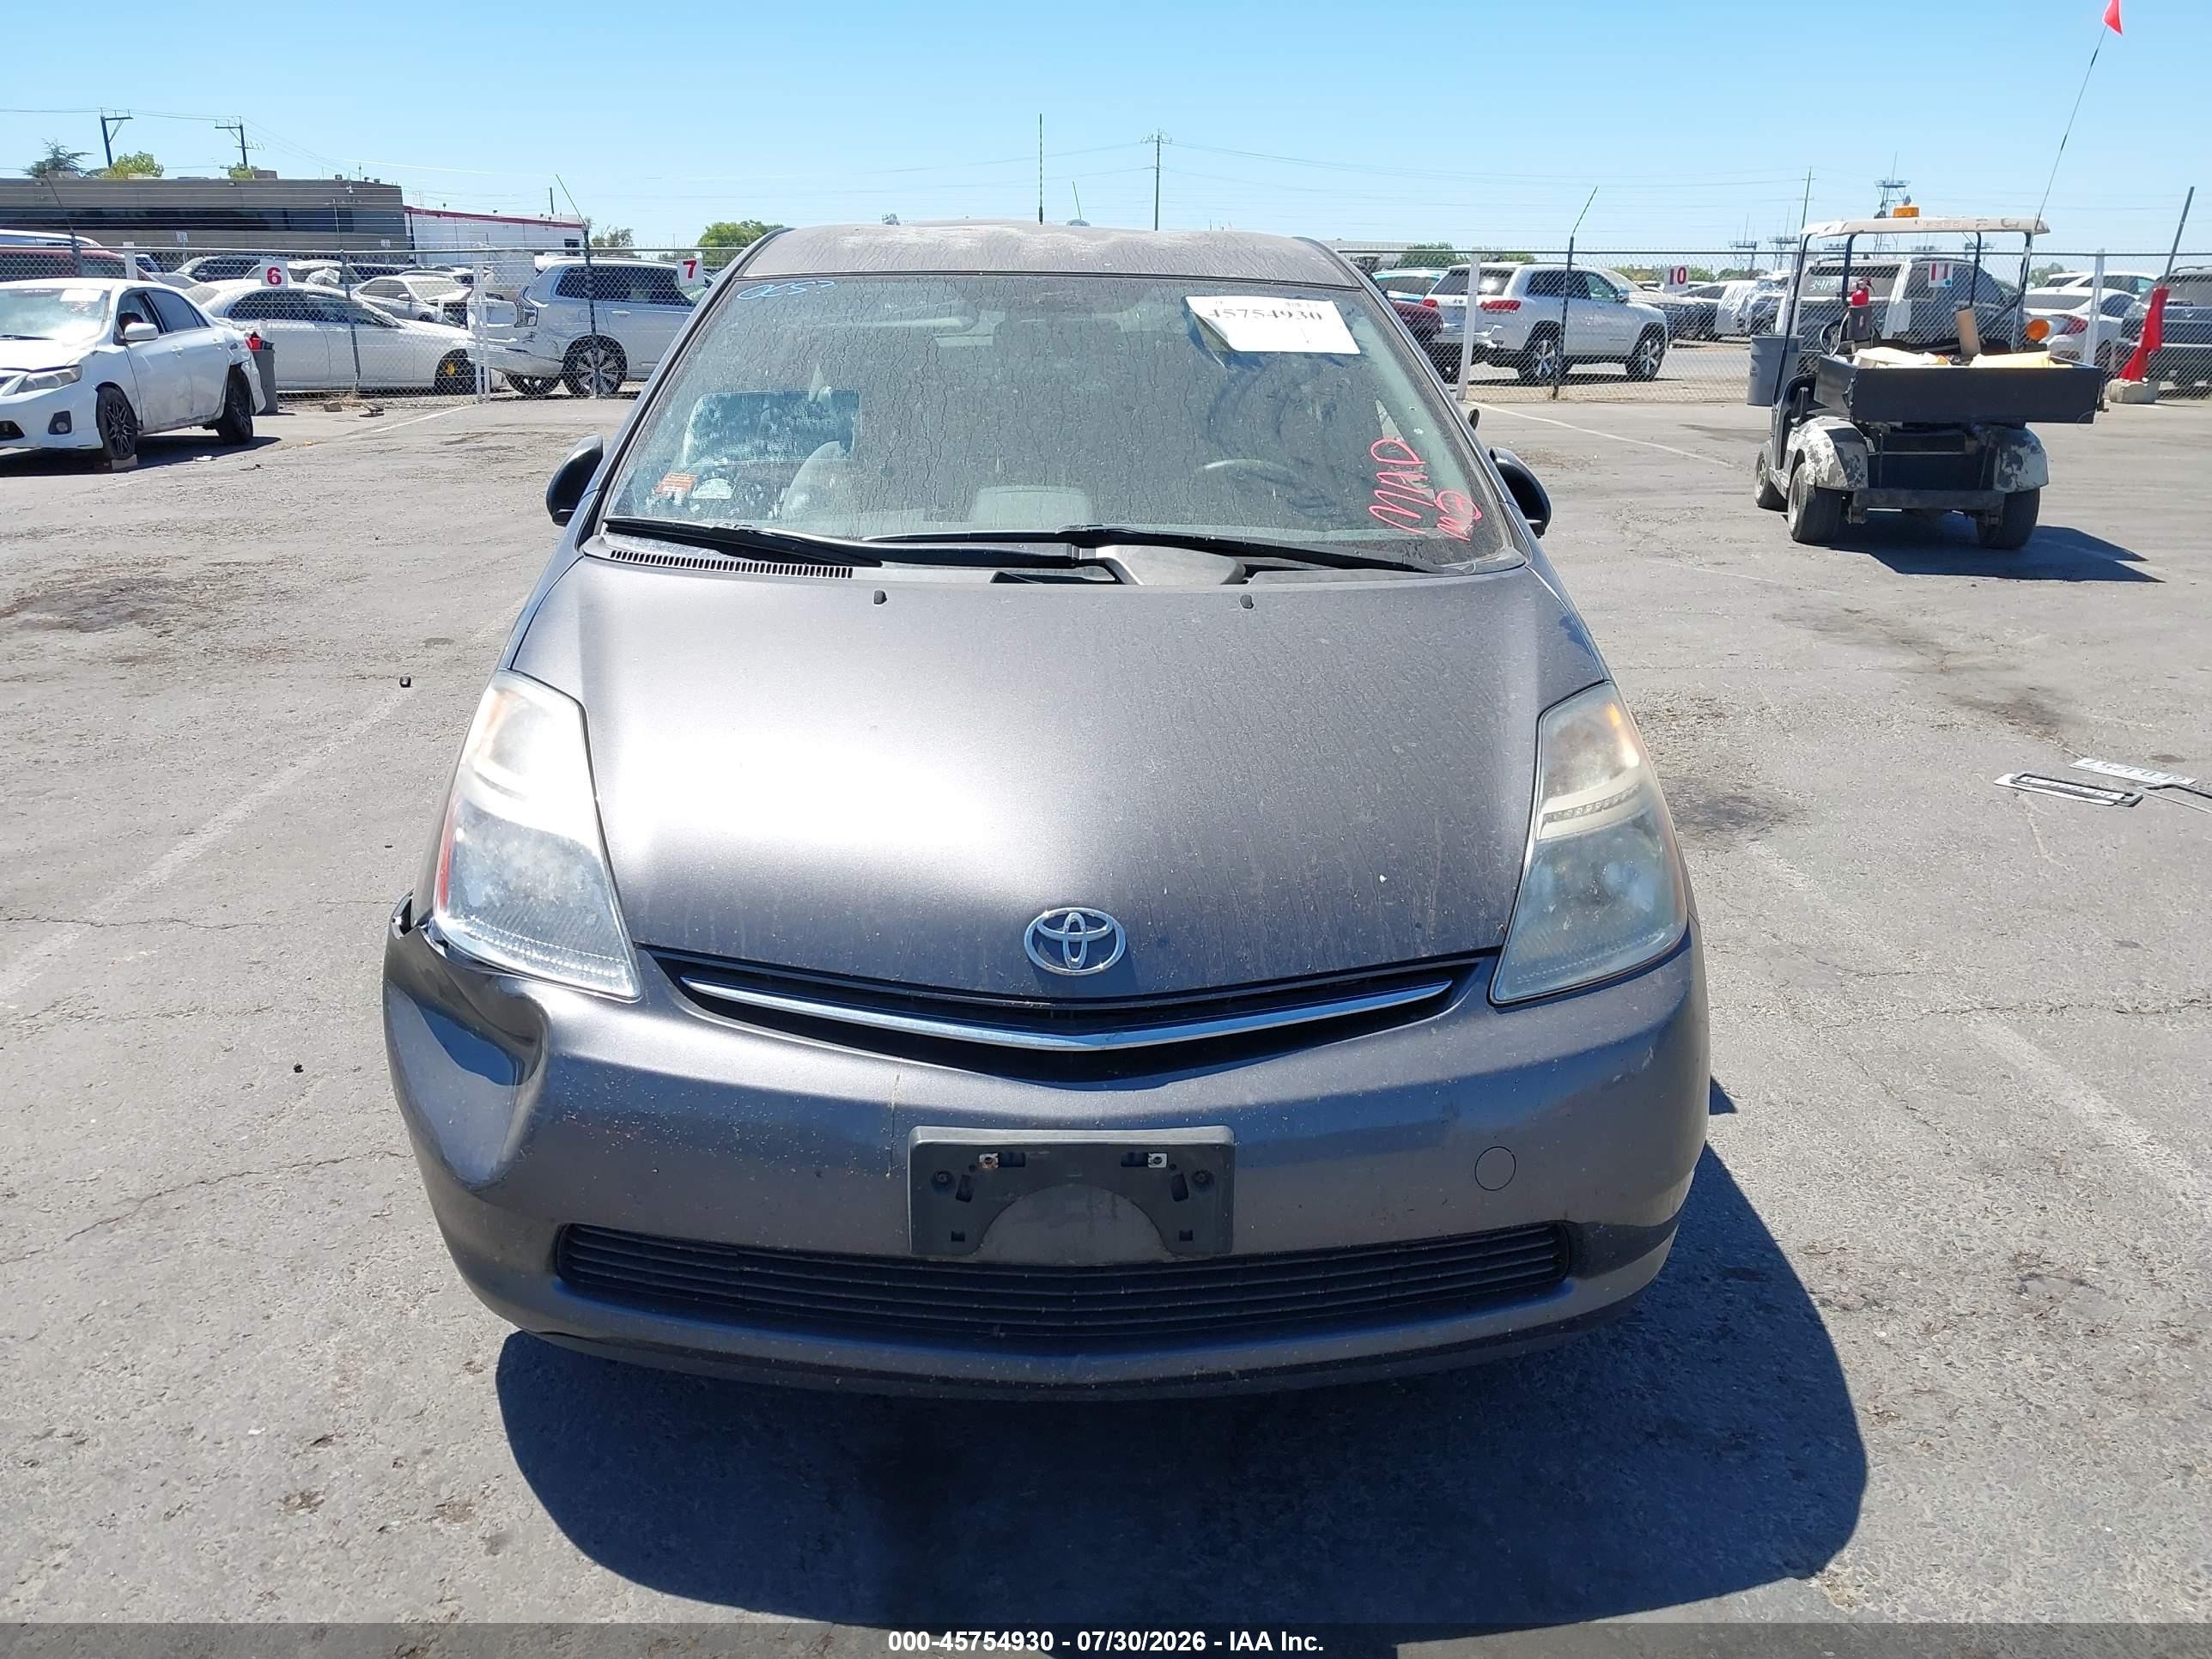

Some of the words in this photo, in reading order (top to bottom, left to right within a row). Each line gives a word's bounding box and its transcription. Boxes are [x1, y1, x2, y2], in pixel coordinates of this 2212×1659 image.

[266, 266, 283, 285] 6
[683, 259, 697, 279] 7
[1668, 266, 1687, 285] 10
[1930, 262, 1949, 281] 11
